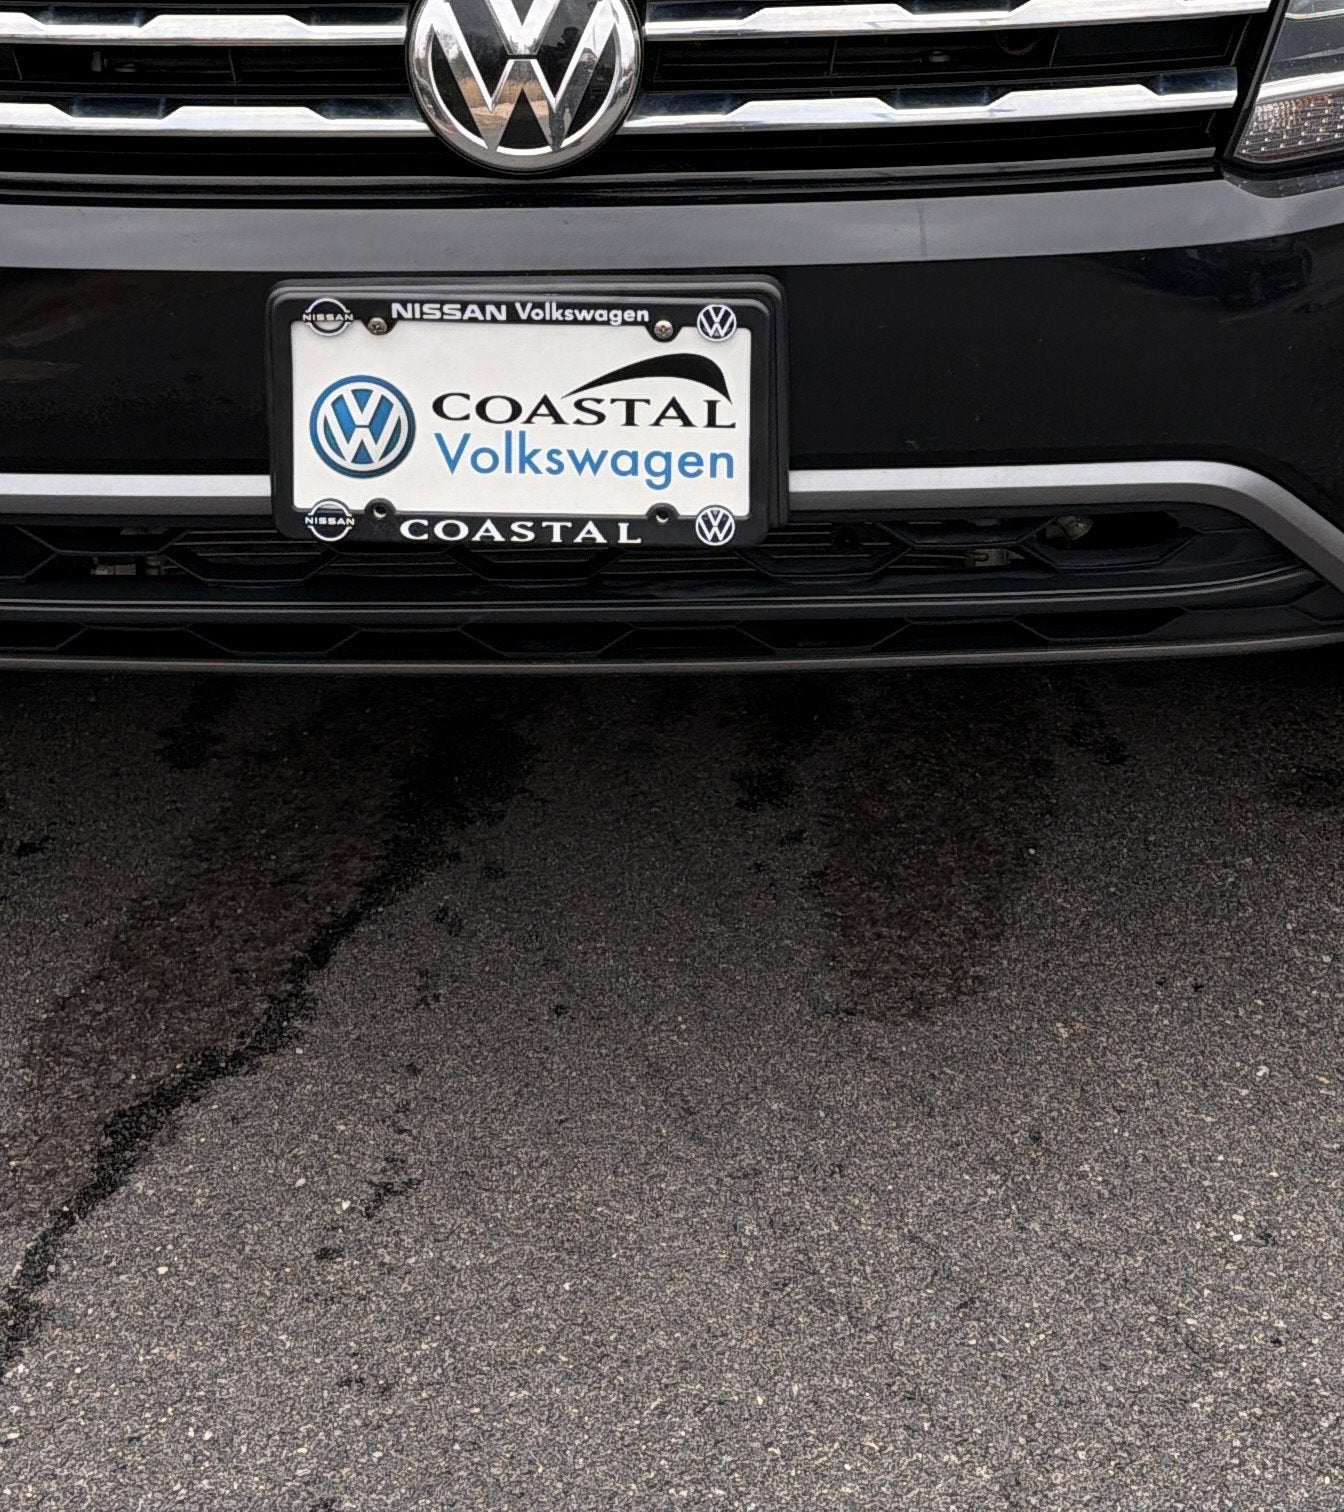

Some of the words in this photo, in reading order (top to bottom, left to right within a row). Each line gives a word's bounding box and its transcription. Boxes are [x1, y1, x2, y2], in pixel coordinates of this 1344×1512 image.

[302, 313, 354, 321] NISSAN
[391, 303, 507, 321] NISSAN
[514, 301, 650, 326] Volkswagen
[432, 391, 736, 429] COASTAL
[433, 430, 735, 490] Volkswagen
[304, 516, 355, 526] NISSAN
[399, 519, 642, 545] COASTAL
